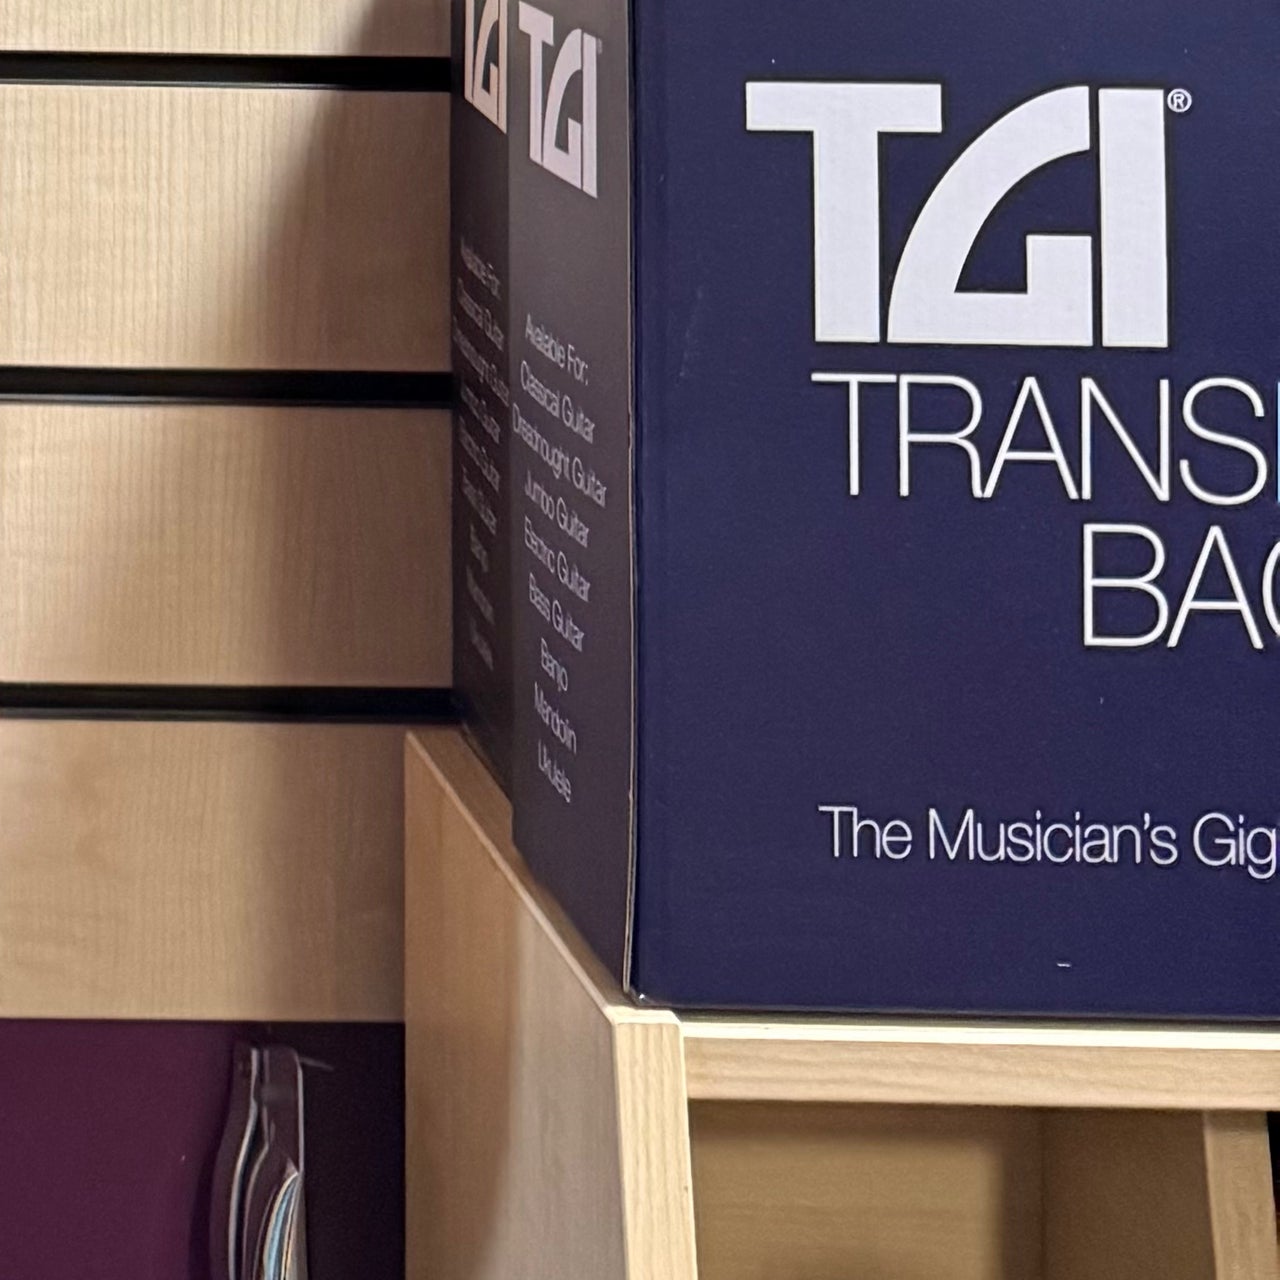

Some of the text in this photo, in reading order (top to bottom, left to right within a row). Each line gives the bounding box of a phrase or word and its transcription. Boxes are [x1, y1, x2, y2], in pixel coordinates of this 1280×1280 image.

[519, 0, 598, 199] TGI
[745, 81, 1168, 348] TGI
[525, 314, 565, 368] Available
[568, 344, 588, 385] For:
[520, 360, 560, 418] Classical
[562, 395, 595, 444] Guitar
[811, 372, 1280, 505] TRANS
[512, 403, 570, 481] Dreadnought
[572, 457, 607, 508] Guitar
[525, 470, 554, 520] Jumbo
[556, 497, 589, 548] Guitar
[524, 516, 555, 574] Electric
[557, 551, 590, 602] Guitar
[1083, 523, 1280, 649] BA
[529, 573, 550, 622] Bass
[552, 600, 584, 652] Guitar
[541, 638, 568, 691] Banjo
[535, 682, 576, 755] Mandolin
[818, 805, 1278, 879] The Musician's Gig
